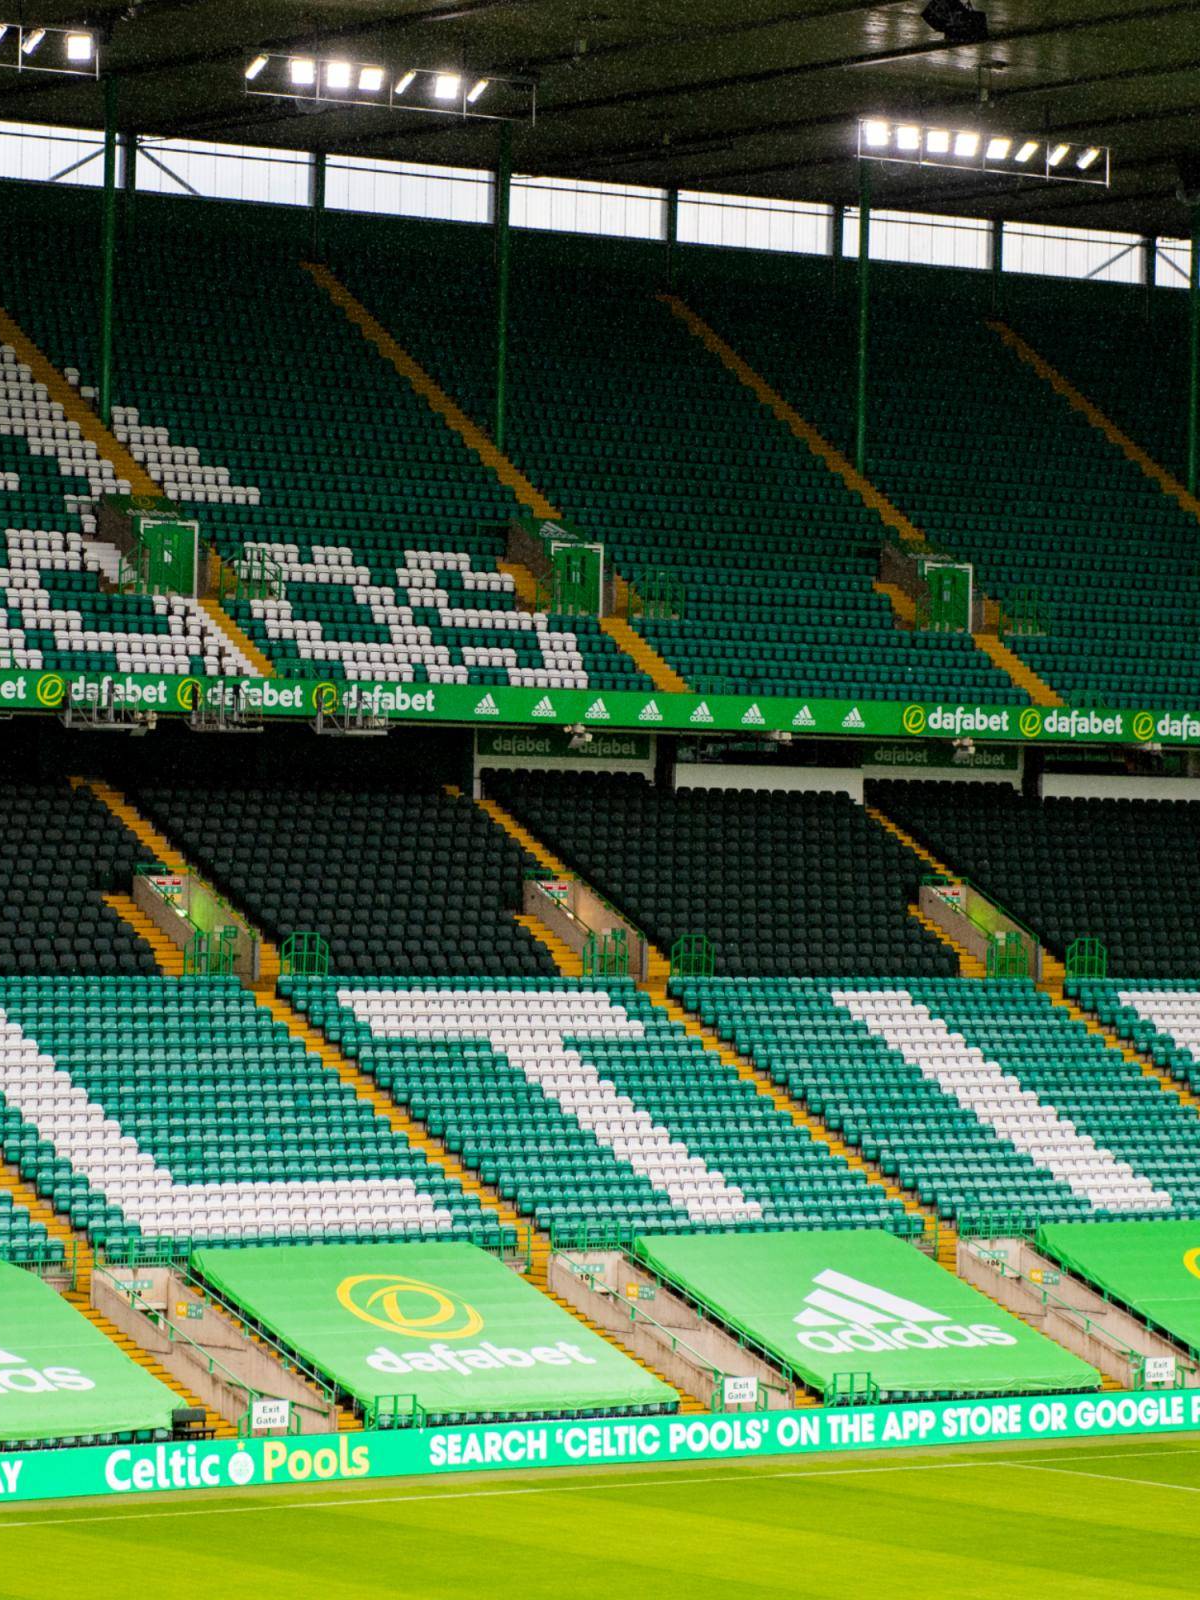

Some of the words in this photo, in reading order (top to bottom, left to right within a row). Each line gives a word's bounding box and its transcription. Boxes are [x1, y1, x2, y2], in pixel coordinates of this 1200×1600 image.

[928, 705, 1009, 735] dafabet
[1044, 710, 1123, 738] dafabet
[1157, 713, 1200, 741] dafa
[796, 1321, 1018, 1354] adidas
[366, 1341, 597, 1376] dafabet
[256, 1416, 277, 1425] Gate
[262, 1406, 280, 1414] Exit
[429, 1429, 547, 1467] SEARCH
[776, 1416, 820, 1448] ON
[827, 1412, 876, 1444] THE
[882, 1408, 936, 1442] APP
[942, 1404, 1022, 1438] STORE
[1028, 1402, 1068, 1433] OR
[1075, 1396, 1184, 1430] GOOGLE
[105, 1443, 220, 1491] Celtic
[263, 1436, 370, 1482] Pools
